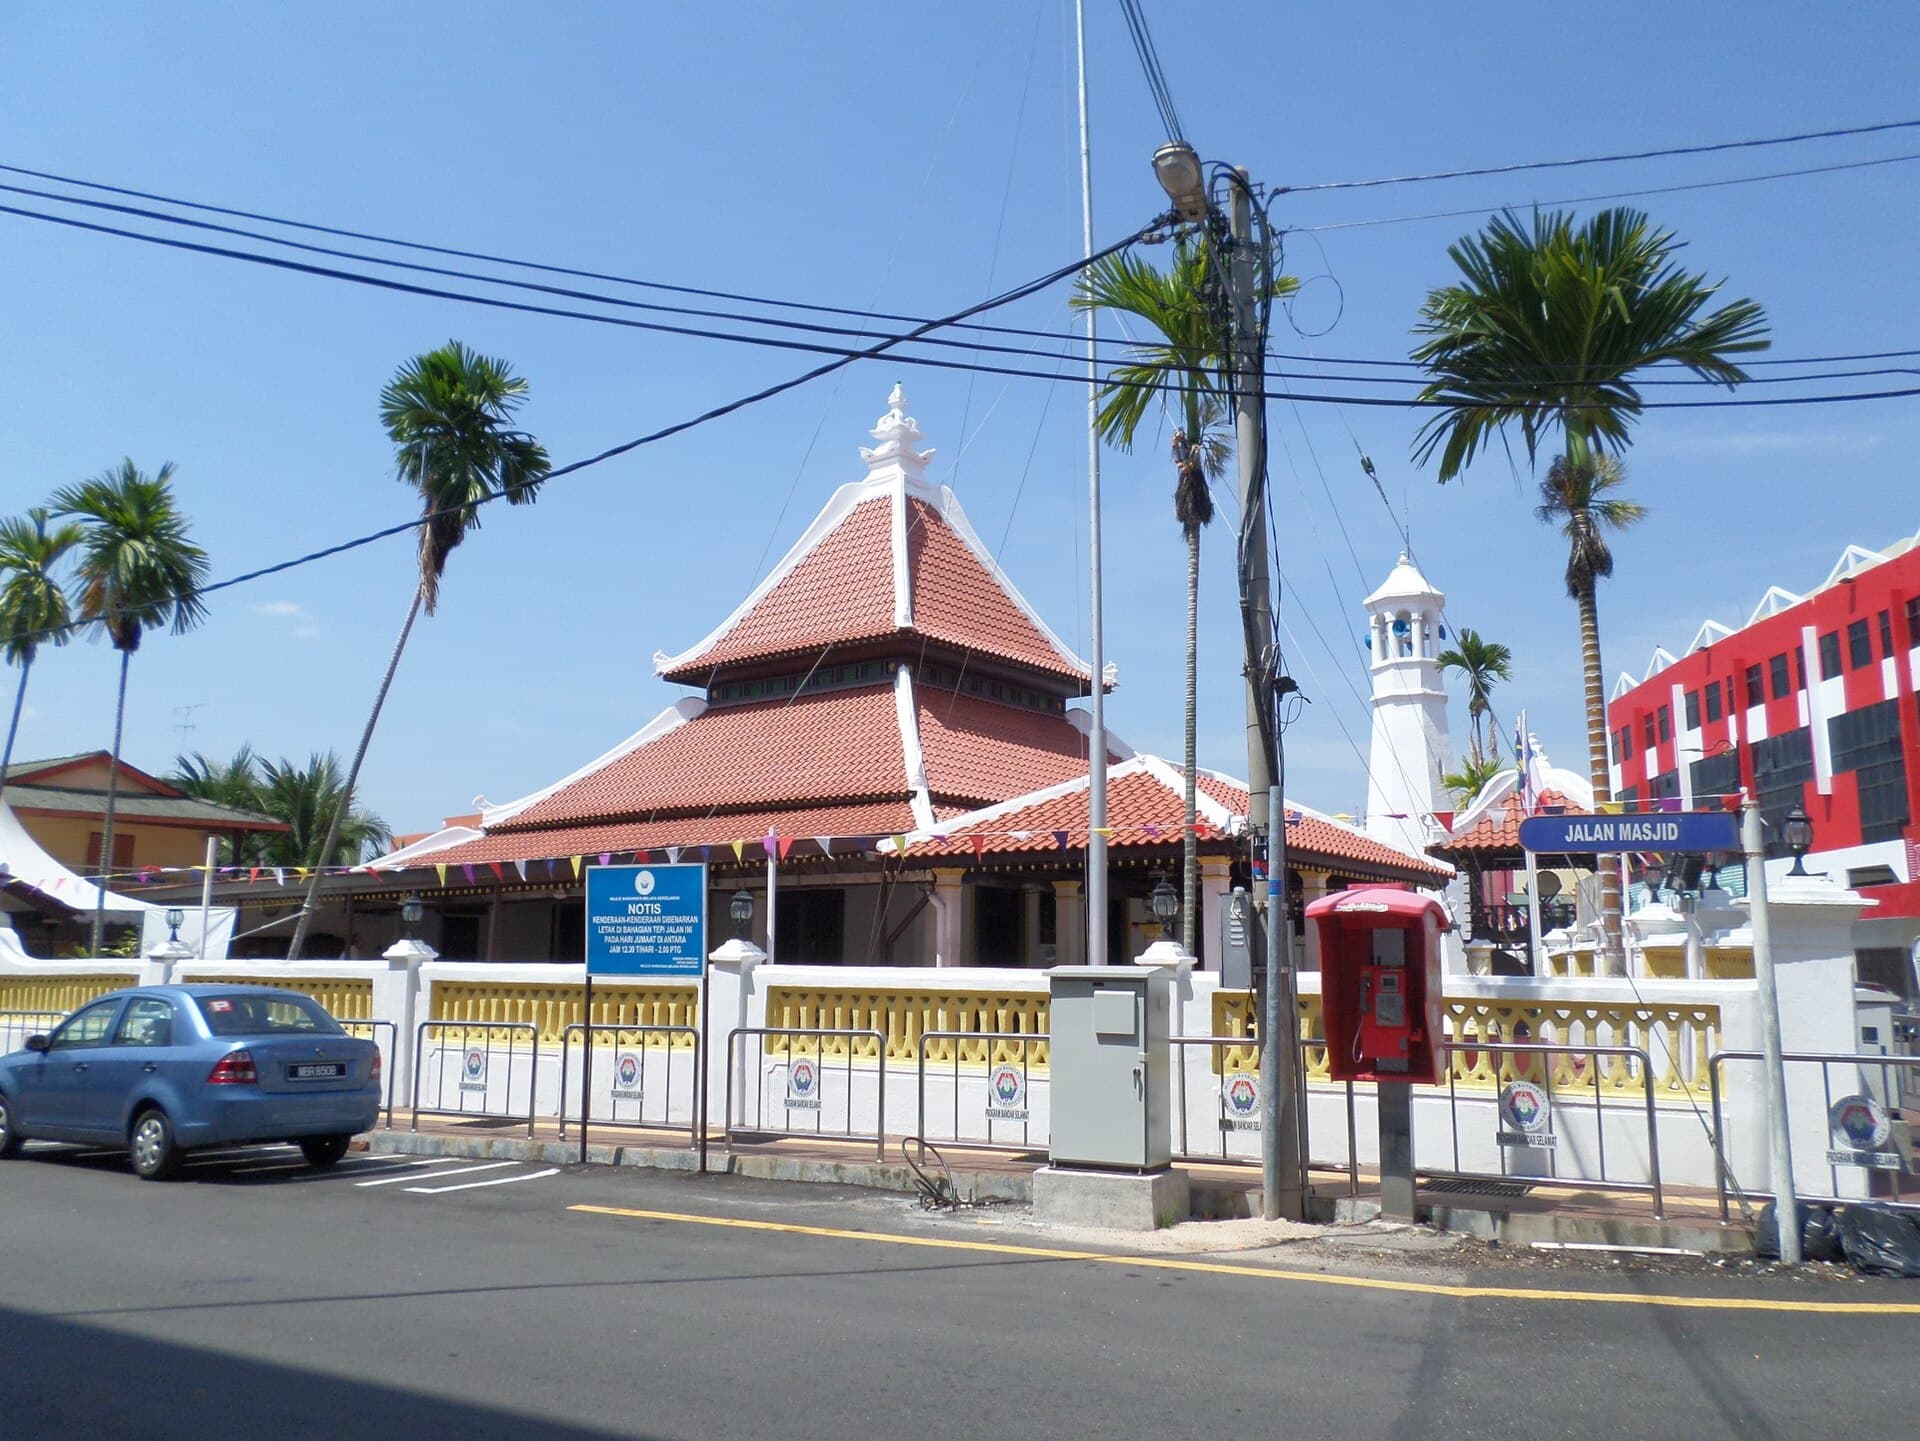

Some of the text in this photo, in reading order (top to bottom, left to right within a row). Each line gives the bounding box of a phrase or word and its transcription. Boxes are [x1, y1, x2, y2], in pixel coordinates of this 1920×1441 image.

[1565, 822, 1678, 842] JALAN MASJID
[628, 903, 661, 915] NOTIS
[662, 915, 698, 924] DIBENARKAN
[598, 926, 616, 934] LETAK
[616, 926, 622, 934] DI
[623, 926, 652, 934] BAHAGIAN
[653, 925, 666, 934] TEPI
[666, 925, 685, 934] JALAN
[604, 936, 619, 944] PADA
[619, 936, 633, 944] HARI
[634, 936, 656, 944] JUMAAT
[663, 935, 687, 943] ANTARA
[609, 946, 621, 954] JAM
[670, 945, 682, 953] PTG
[213, 1000, 230, 1011] P
[985, 1109, 1029, 1120] PROGRAM BANDAR SELAMAT
[1536, 1134, 1557, 1146] SELAMAT
[1826, 1152, 1851, 1162] PROGRAM
